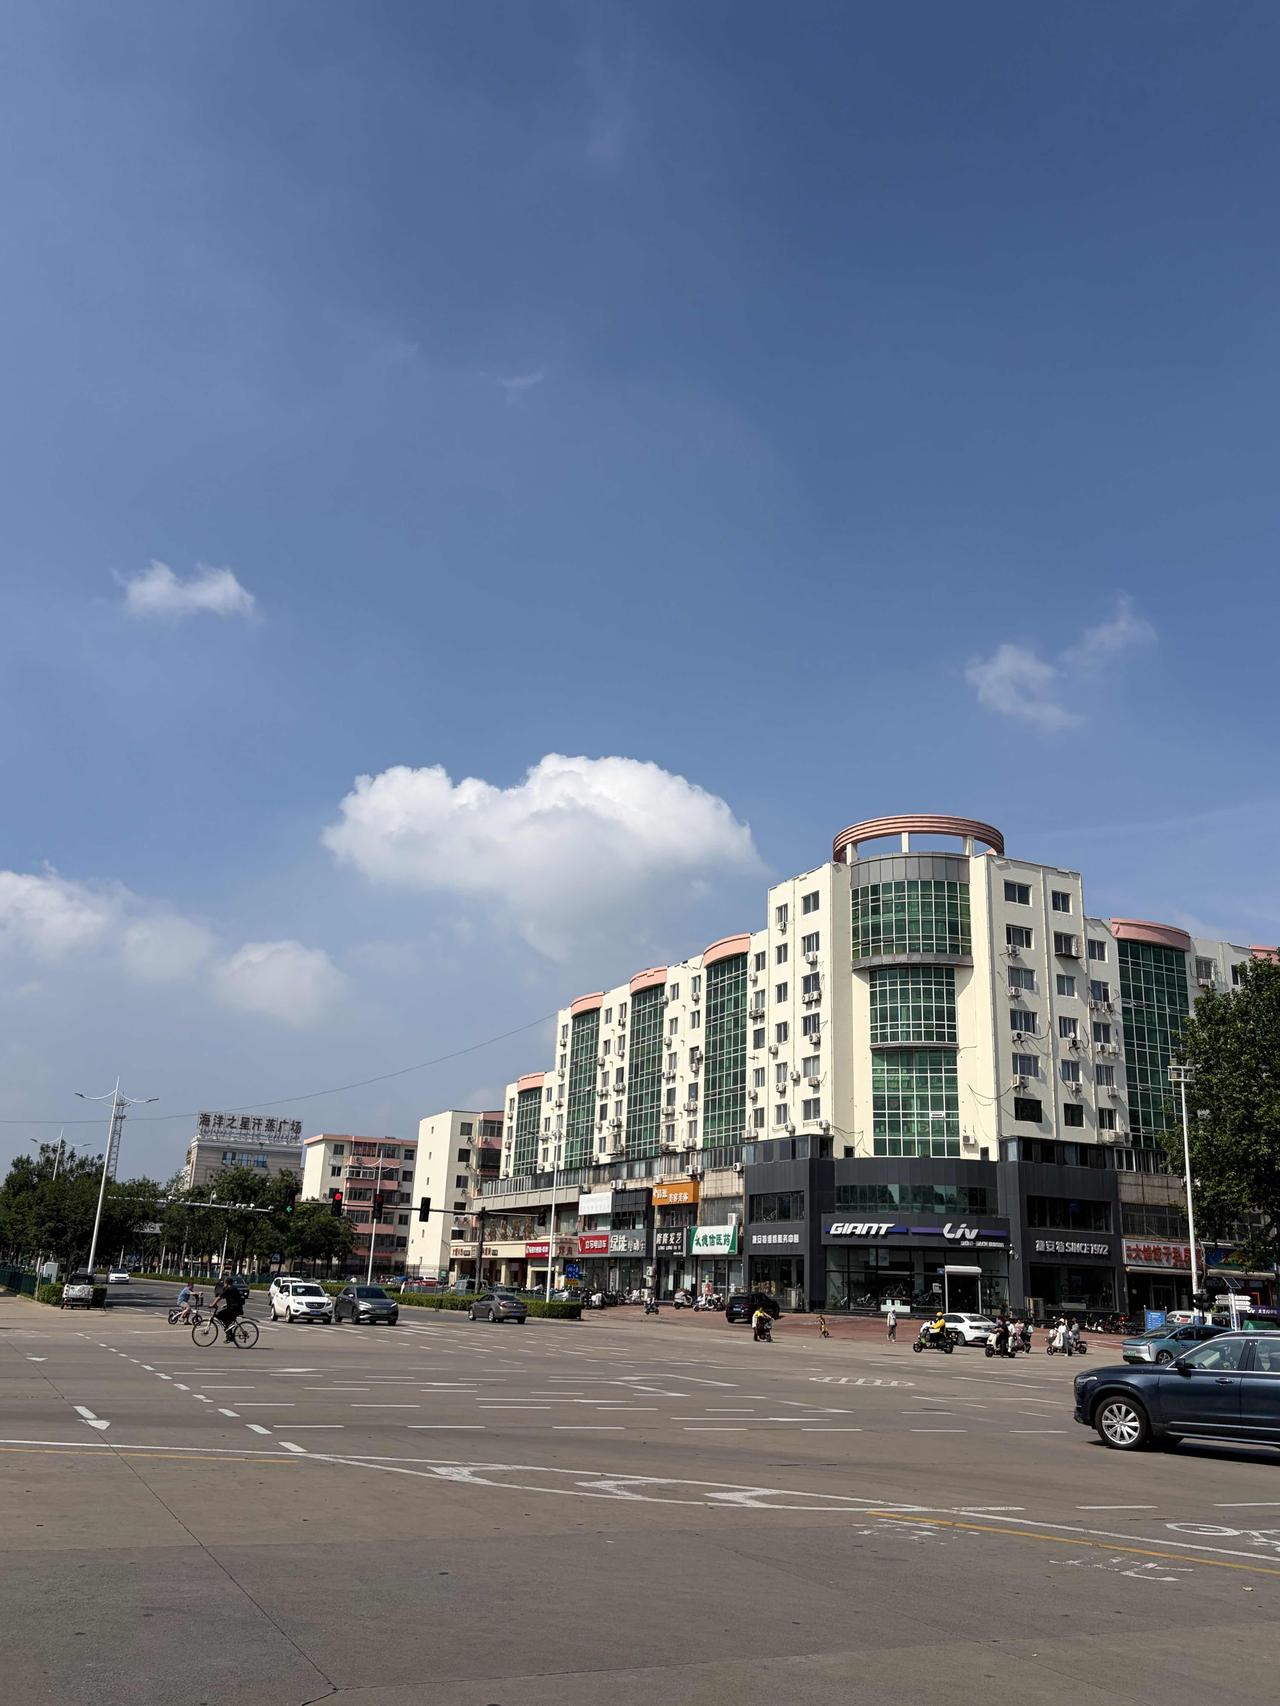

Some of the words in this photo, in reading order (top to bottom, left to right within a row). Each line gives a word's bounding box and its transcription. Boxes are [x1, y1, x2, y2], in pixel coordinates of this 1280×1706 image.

[198, 1112, 302, 1134] 海洋之星汗蒸广场
[829, 1222, 895, 1235] GIANT
[942, 1222, 979, 1240] Liv
